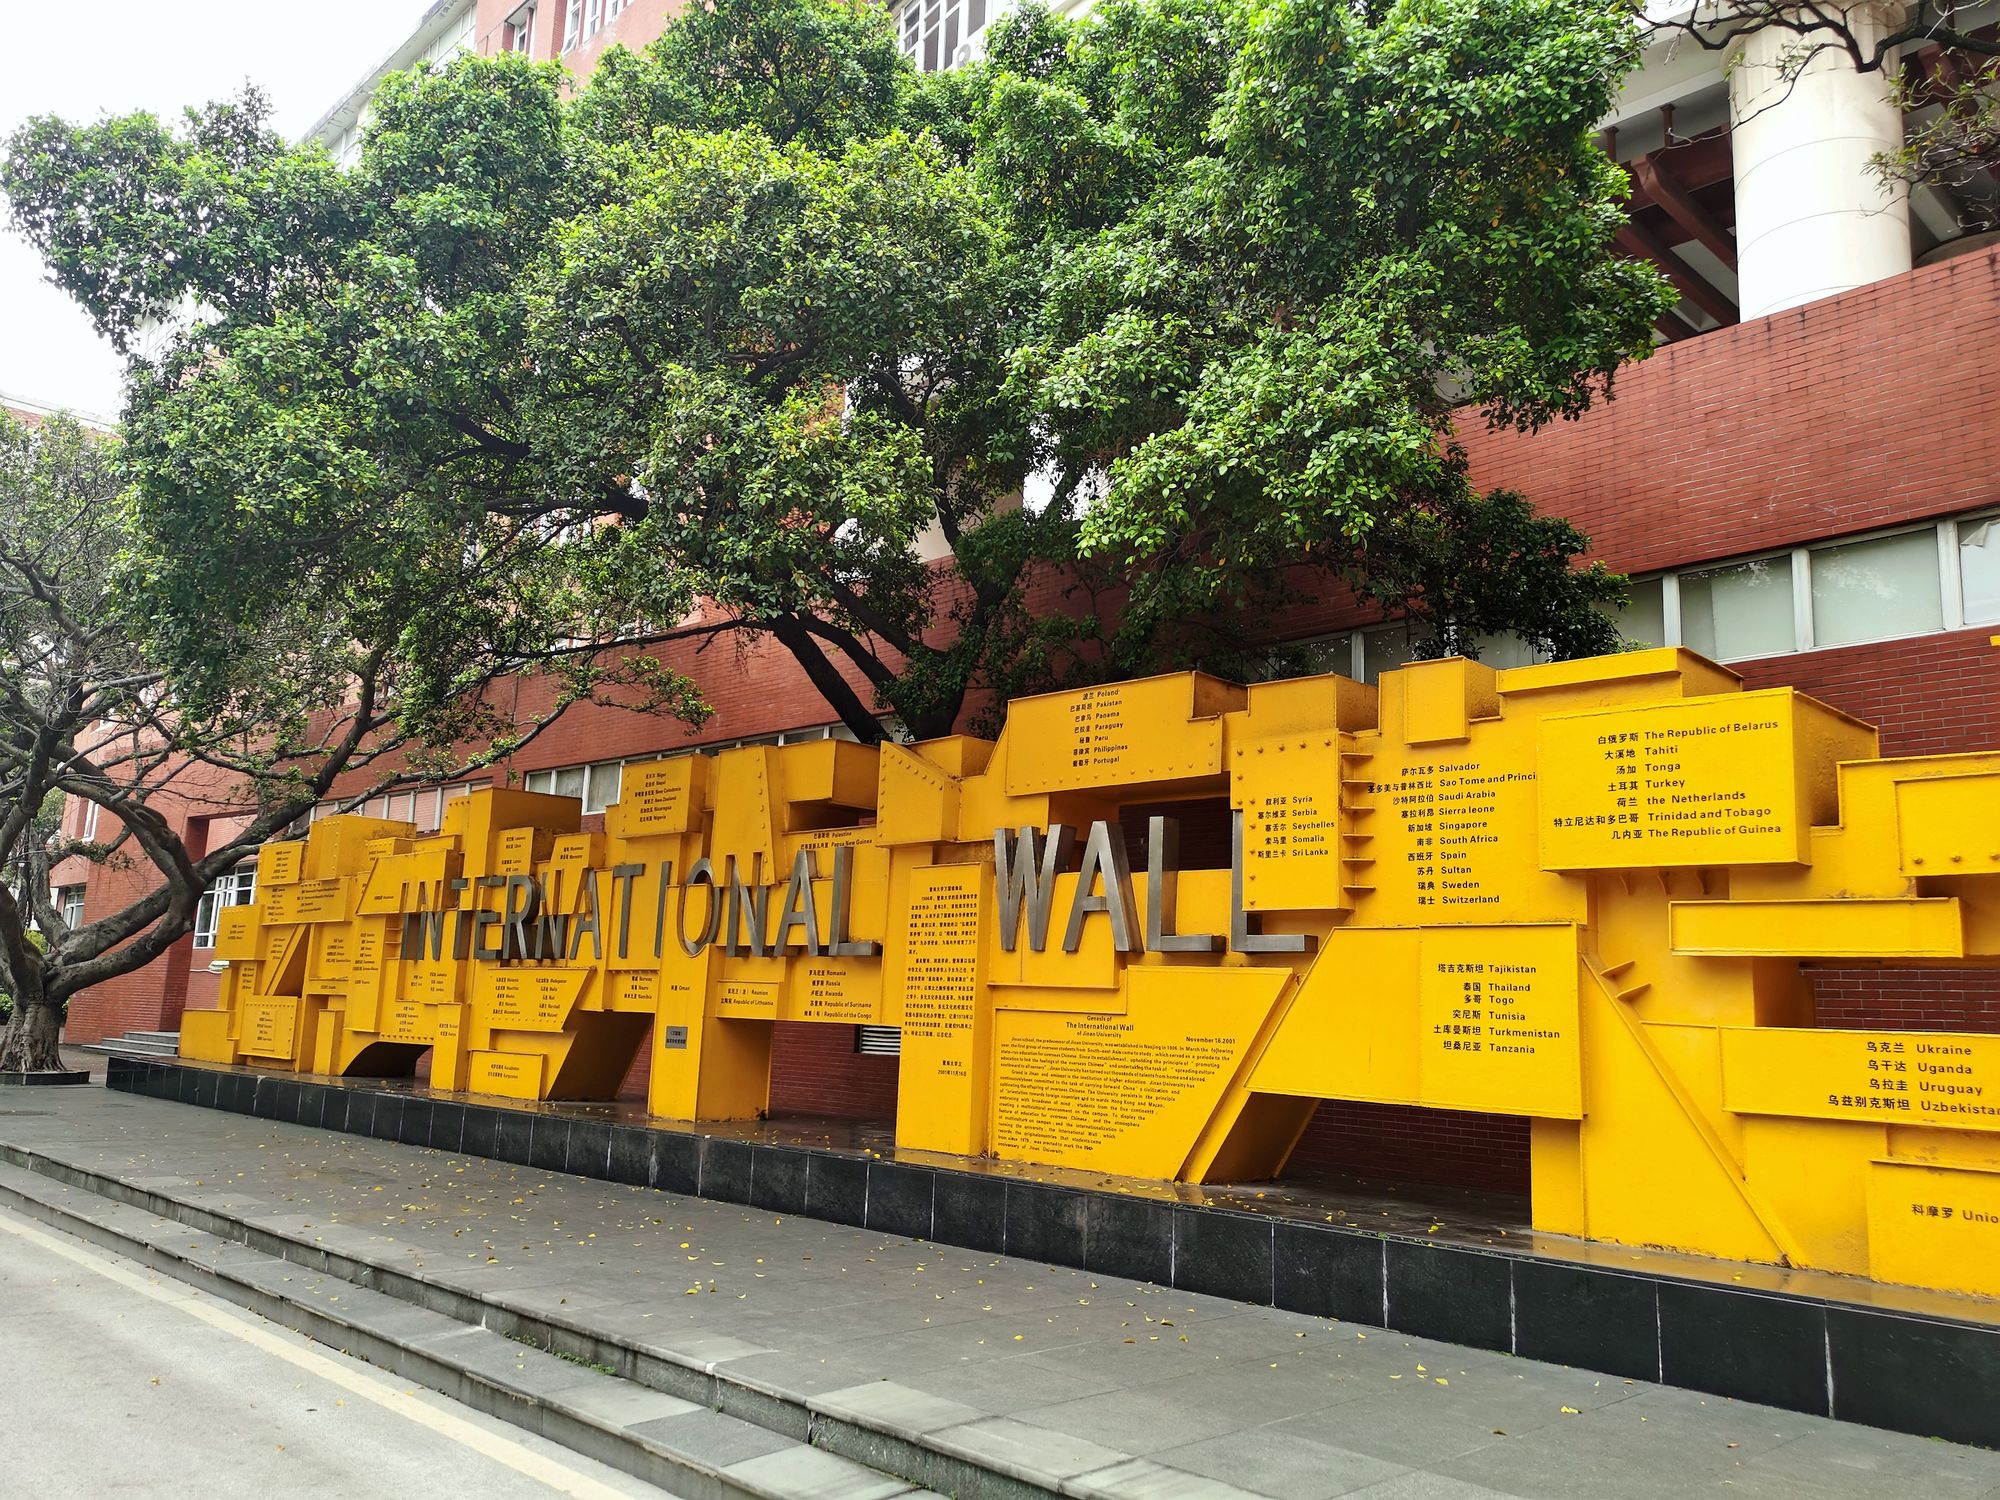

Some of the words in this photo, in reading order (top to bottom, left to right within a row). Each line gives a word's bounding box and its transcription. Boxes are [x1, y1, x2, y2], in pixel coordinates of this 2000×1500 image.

[1097, 689, 1119, 698] Poland
[1096, 700, 1123, 708] Pakistan
[1095, 722, 1124, 731] Paraguay
[1598, 733, 1639, 745] 白俄罗斯
[1645, 731, 1665, 740] The
[1668, 726, 1717, 739] Republic
[1720, 724, 1731, 733] of
[1734, 720, 1779, 732] Belarus
[1093, 745, 1128, 753] Philippines
[1605, 749, 1636, 760] 大溪地
[1645, 745, 1679, 756] Tahiti
[1093, 756, 1120, 764] Portugal
[1401, 765, 1434, 776] 萨尔瓦多
[1439, 763, 1480, 773] Salvador
[1616, 764, 1637, 775] 汤加
[1645, 762, 1681, 774] Tonga
[1440, 779, 1457, 788] Sao
[1459, 777, 1485, 786] Tome
[1487, 774, 1505, 783] and
[1608, 781, 1639, 792] 土耳其
[1645, 778, 1686, 790] Turkey
[1292, 796, 1312, 804] Syria
[1393, 794, 1434, 805] 沙特阿拉伯
[1438, 793, 1464, 801] Saudi
[1466, 790, 1496, 799] Arabia
[1617, 796, 1638, 807] 荷兰
[1647, 796, 1666, 805] the
[1671, 791, 1747, 804] Netherlands
[1292, 809, 1317, 817] Serbia
[1439, 806, 1466, 815] Sierra
[1468, 804, 1495, 813] leone
[1553, 813, 1639, 828] 特立尼达和多巴哥
[1648, 810, 1697, 822] Trinidad
[1699, 808, 1722, 819] and
[1725, 807, 1772, 819] Tobago
[1292, 821, 1335, 831] Seychelles
[1408, 823, 1433, 833] 新加坡
[1439, 820, 1488, 831] Singapore
[1612, 829, 1643, 840] 几内亚
[1648, 828, 1668, 838] The
[1672, 825, 1722, 838] Republic
[1724, 824, 1736, 834] of
[1738, 823, 1782, 834] Guinea
[1292, 834, 1324, 843] Somalia
[1417, 838, 1433, 847] 南非
[1440, 837, 1468, 845] South
[1470, 834, 1499, 843] Africa
[1292, 849, 1304, 857] Sri
[1305, 848, 1329, 856] Lanka
[1408, 852, 1433, 861] 西班牙
[1440, 850, 1467, 860] Spain
[1417, 867, 1434, 876] 苏丹
[1441, 865, 1472, 874] Sultan
[401, 847, 880, 959] INTERNATIONAL
[994, 806, 1312, 952] WALL
[1418, 882, 1435, 891] 瑞典
[1442, 880, 1480, 889] Sweden
[1418, 896, 1435, 905] 瑞士
[1442, 895, 1500, 904] Switzerland
[1438, 963, 1484, 974] 塔吉克斯坦
[1488, 964, 1537, 975] Tajikistan
[1463, 981, 1481, 992] 泰国
[1488, 983, 1531, 992] Thailand
[1464, 994, 1482, 1004] 多哥
[1489, 995, 1514, 1006] Togo
[1452, 1009, 1481, 1020] 突尼斯
[1489, 1011, 1526, 1021] Tunisia
[1066, 1021, 1077, 1029] The
[1077, 1022, 1119, 1031] International
[1433, 1024, 1481, 1036] 土库曼斯坦
[1489, 1027, 1561, 1039] Turkmenistan
[1185, 1036, 1214, 1044] November
[1443, 1040, 1482, 1051] 坦桑尼亚
[1489, 1043, 1535, 1054] Tanzania
[1866, 1041, 1905, 1053] 乌克兰
[1916, 1044, 1972, 1056] Ukraine
[1868, 1059, 1907, 1072] 乌干达
[1917, 1062, 1973, 1075] Uganda
[1869, 1078, 1909, 1091] 乌拉圭
[1919, 1081, 1983, 1097] Uruguay
[1828, 1094, 1911, 1111] 乌兹别克斯坦
[1911, 1203, 1953, 1219] 科摩罗
